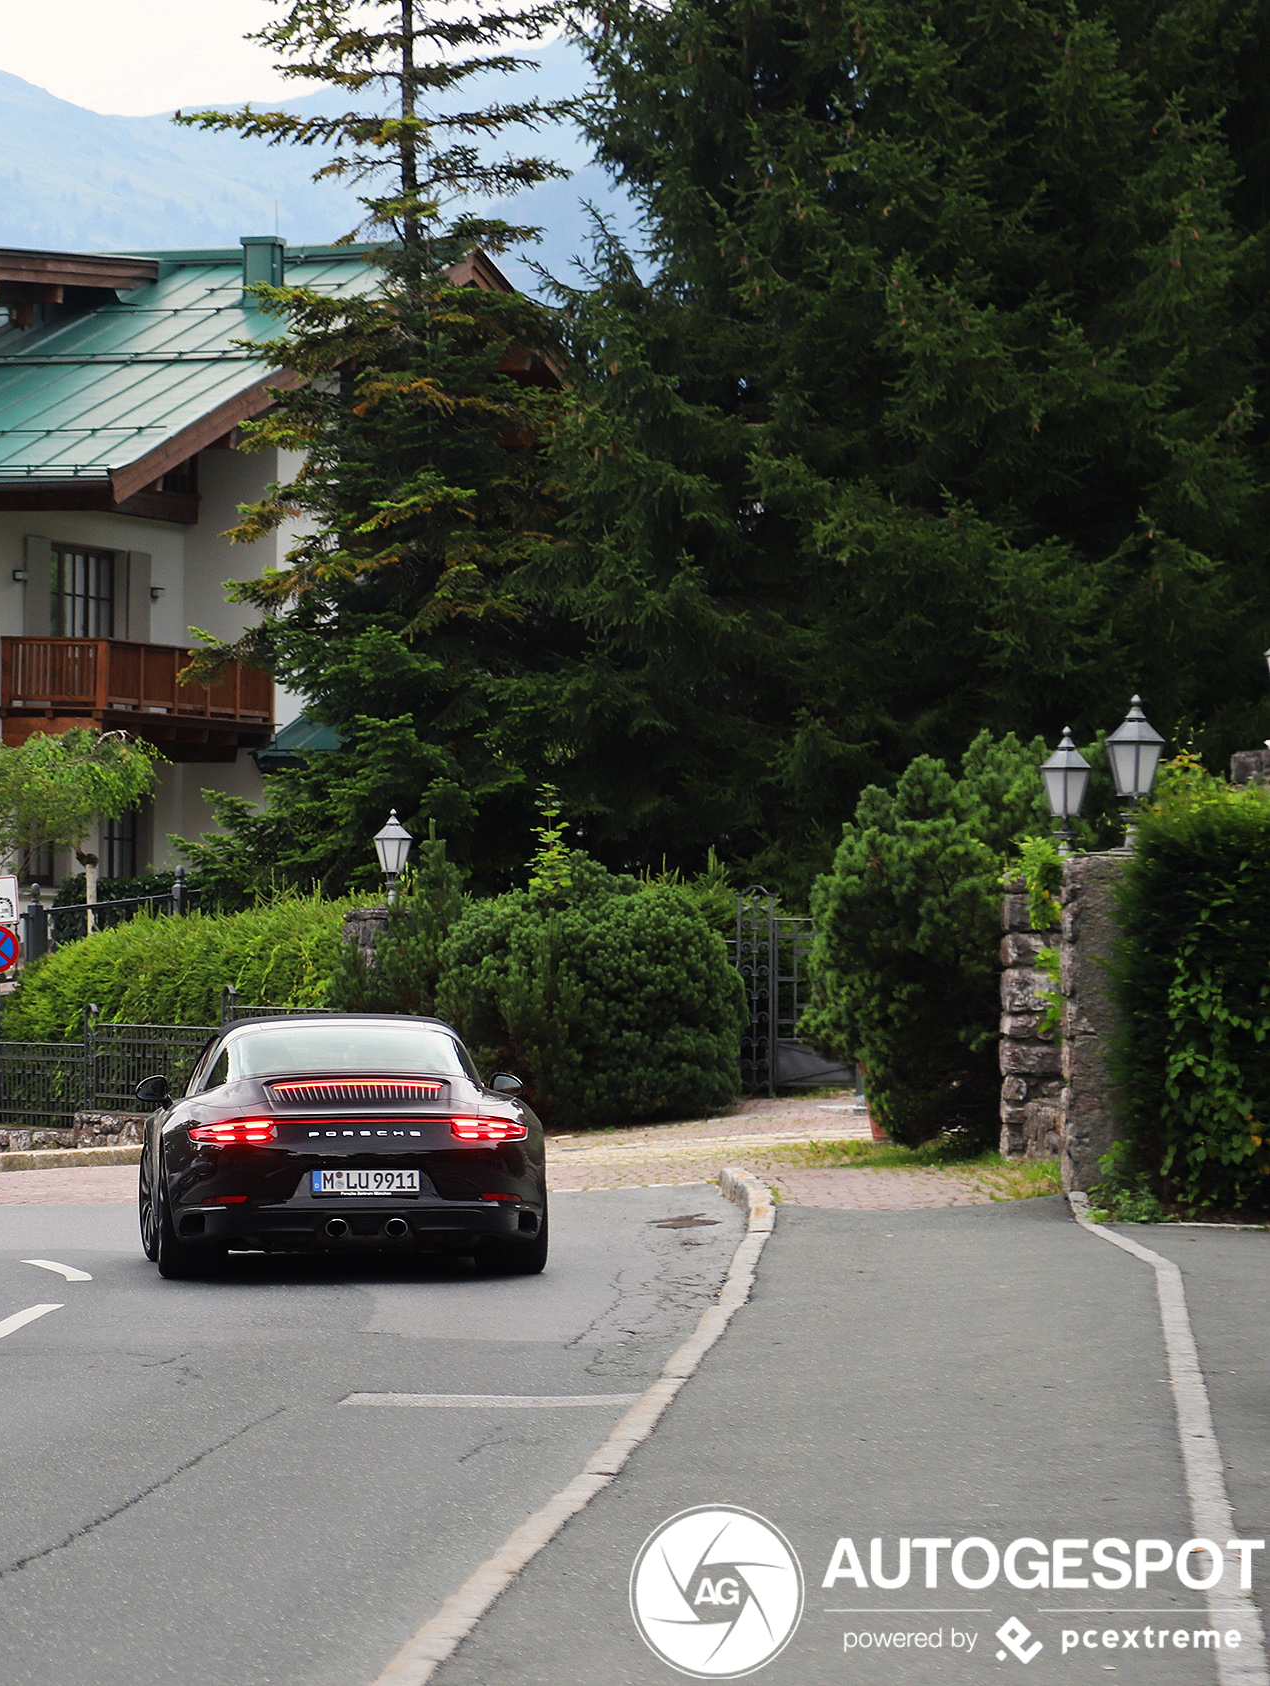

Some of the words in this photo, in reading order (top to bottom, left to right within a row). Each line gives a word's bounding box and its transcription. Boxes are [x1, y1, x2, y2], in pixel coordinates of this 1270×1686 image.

[308, 1130, 422, 1138] PORSCHE
[323, 1172, 334, 1189] M
[346, 1172, 369, 1189] LU
[373, 1172, 417, 1189] 9911
